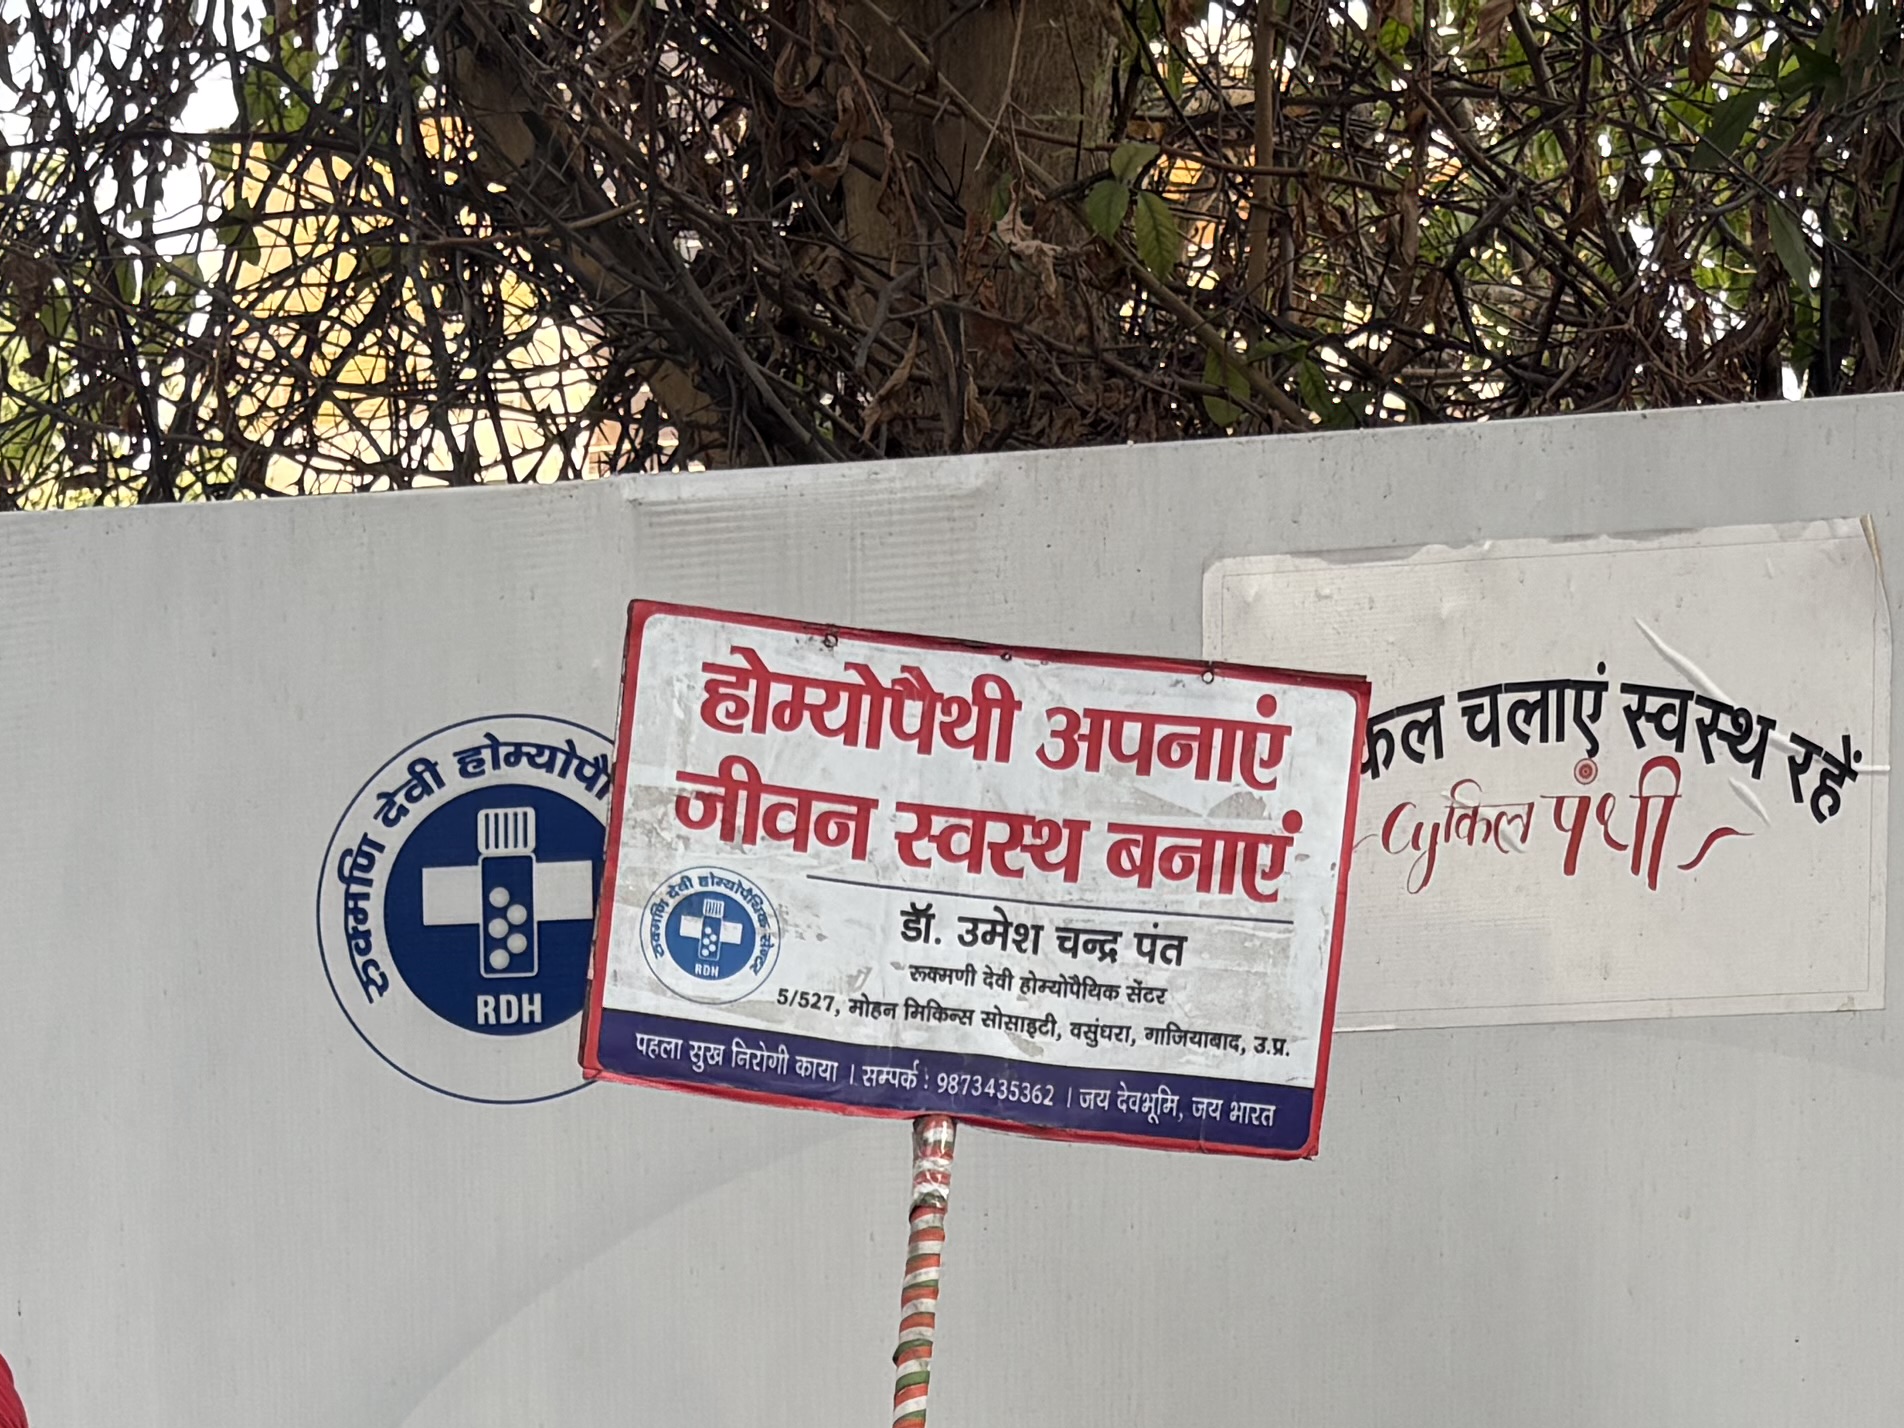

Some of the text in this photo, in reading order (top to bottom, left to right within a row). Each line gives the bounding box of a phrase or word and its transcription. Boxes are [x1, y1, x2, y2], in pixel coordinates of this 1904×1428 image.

[701, 646, 1292, 792] होम्योपैथी अपनाएं
[1458, 661, 1609, 761] चलाएं
[1620, 682, 1776, 780] स्वस्थ
[1784, 732, 1865, 824] रहें
[373, 757, 446, 828] देवी
[452, 732, 612, 801] होम्योपै
[675, 756, 1304, 903] जीवन स्वस्थ बनाएं
[900, 902, 1188, 967] डॉ. उमेश चन्द्र पंत
[476, 993, 542, 1025] RDH
[777, 988, 1290, 1057] 5/527, मोहन मिकिन्स सोसाइटी, वसुंधरा, गाजियाबाद, उ.प्र.
[983, 965, 1014, 992] देवी
[1019, 972, 1120, 1003] होम्योपैथिक
[1126, 979, 1168, 1006] सेंटर
[635, 1032, 682, 1061] पहला
[688, 1039, 725, 1072] सुख
[731, 1037, 790, 1074] निरोगी
[795, 1056, 838, 1083] काया
[862, 1059, 920, 1091] सम्पर्क
[937, 1071, 1054, 1107] 9873435362
[1079, 1087, 1110, 1111] जय
[1117, 1082, 1184, 1126] देवभूमि,
[1192, 1096, 1221, 1121] जय
[1229, 1100, 1275, 1128] भारत
